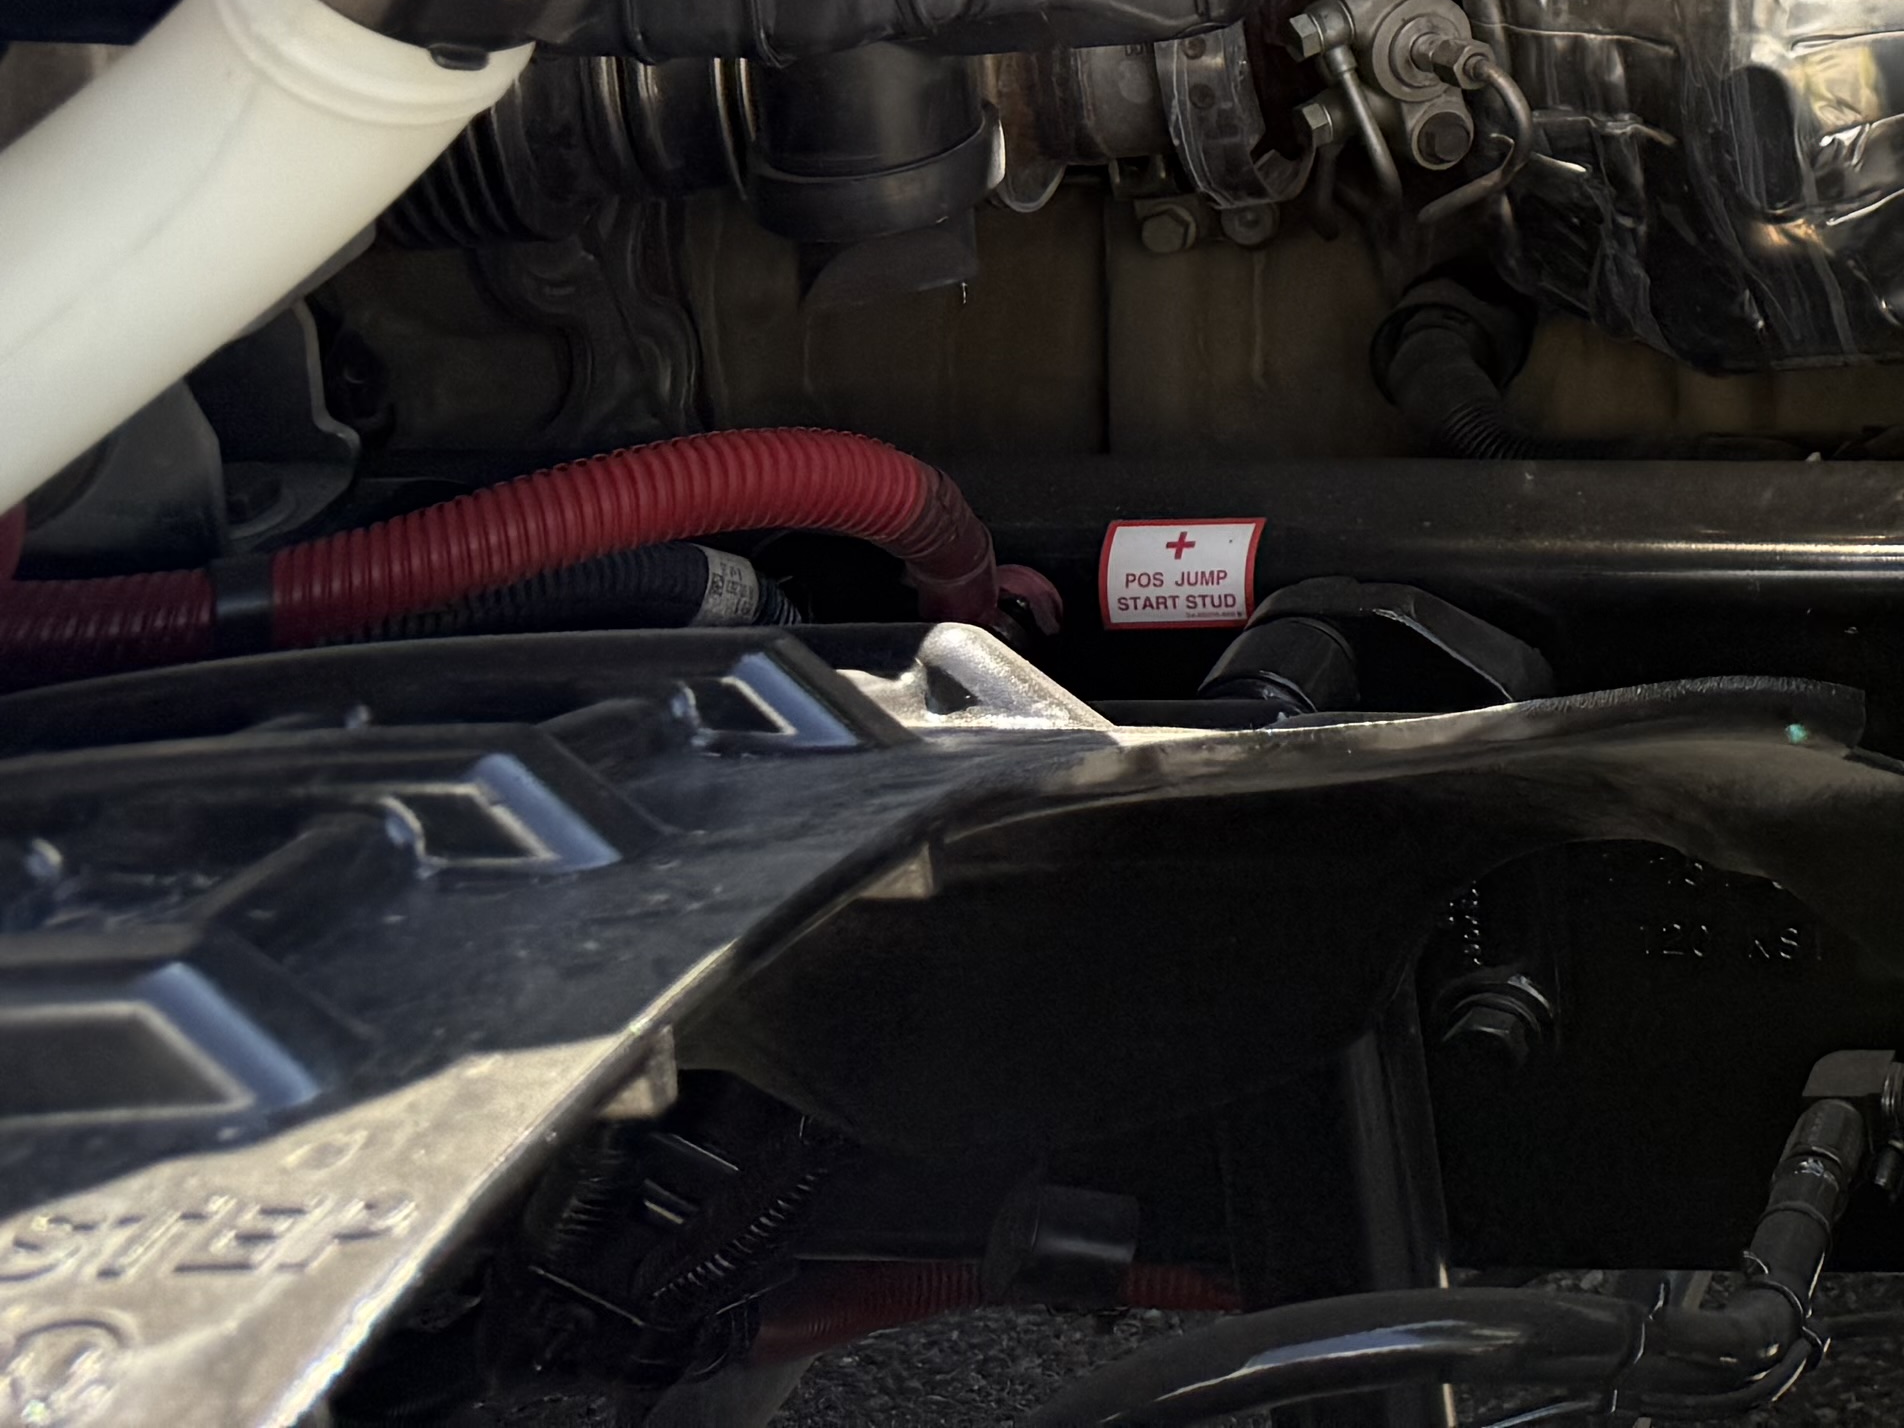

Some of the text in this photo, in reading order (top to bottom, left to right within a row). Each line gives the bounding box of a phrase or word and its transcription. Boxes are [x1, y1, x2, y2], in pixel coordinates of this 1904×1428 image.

[1125, 570, 1228, 589] POS JUMP
[1117, 593, 1236, 611] START STUD
[0, 1196, 416, 1280] STEP
